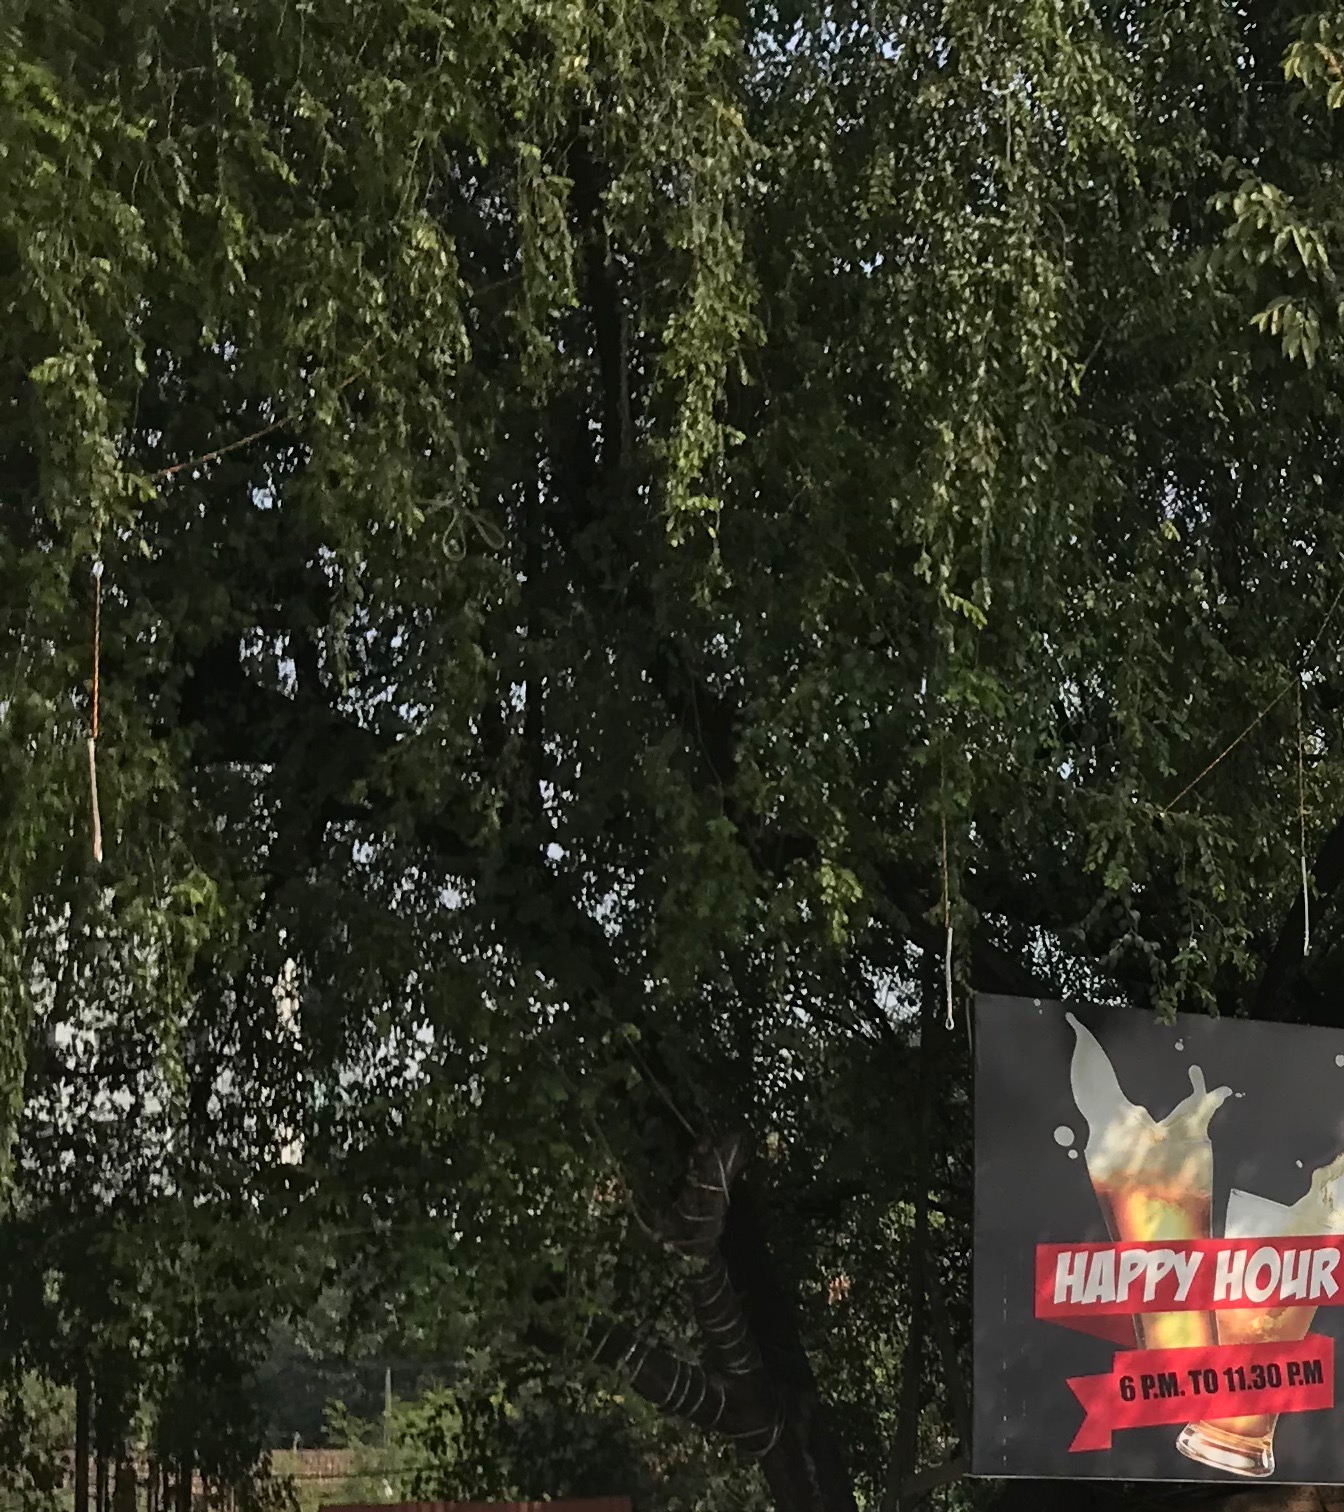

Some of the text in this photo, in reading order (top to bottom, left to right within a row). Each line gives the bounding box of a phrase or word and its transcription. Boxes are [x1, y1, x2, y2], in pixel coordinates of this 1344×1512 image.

[1054, 1246, 1341, 1304] HAPPY HOUR
[1119, 1359, 1324, 1401] 6 P.M. TO 11.30 P.M
